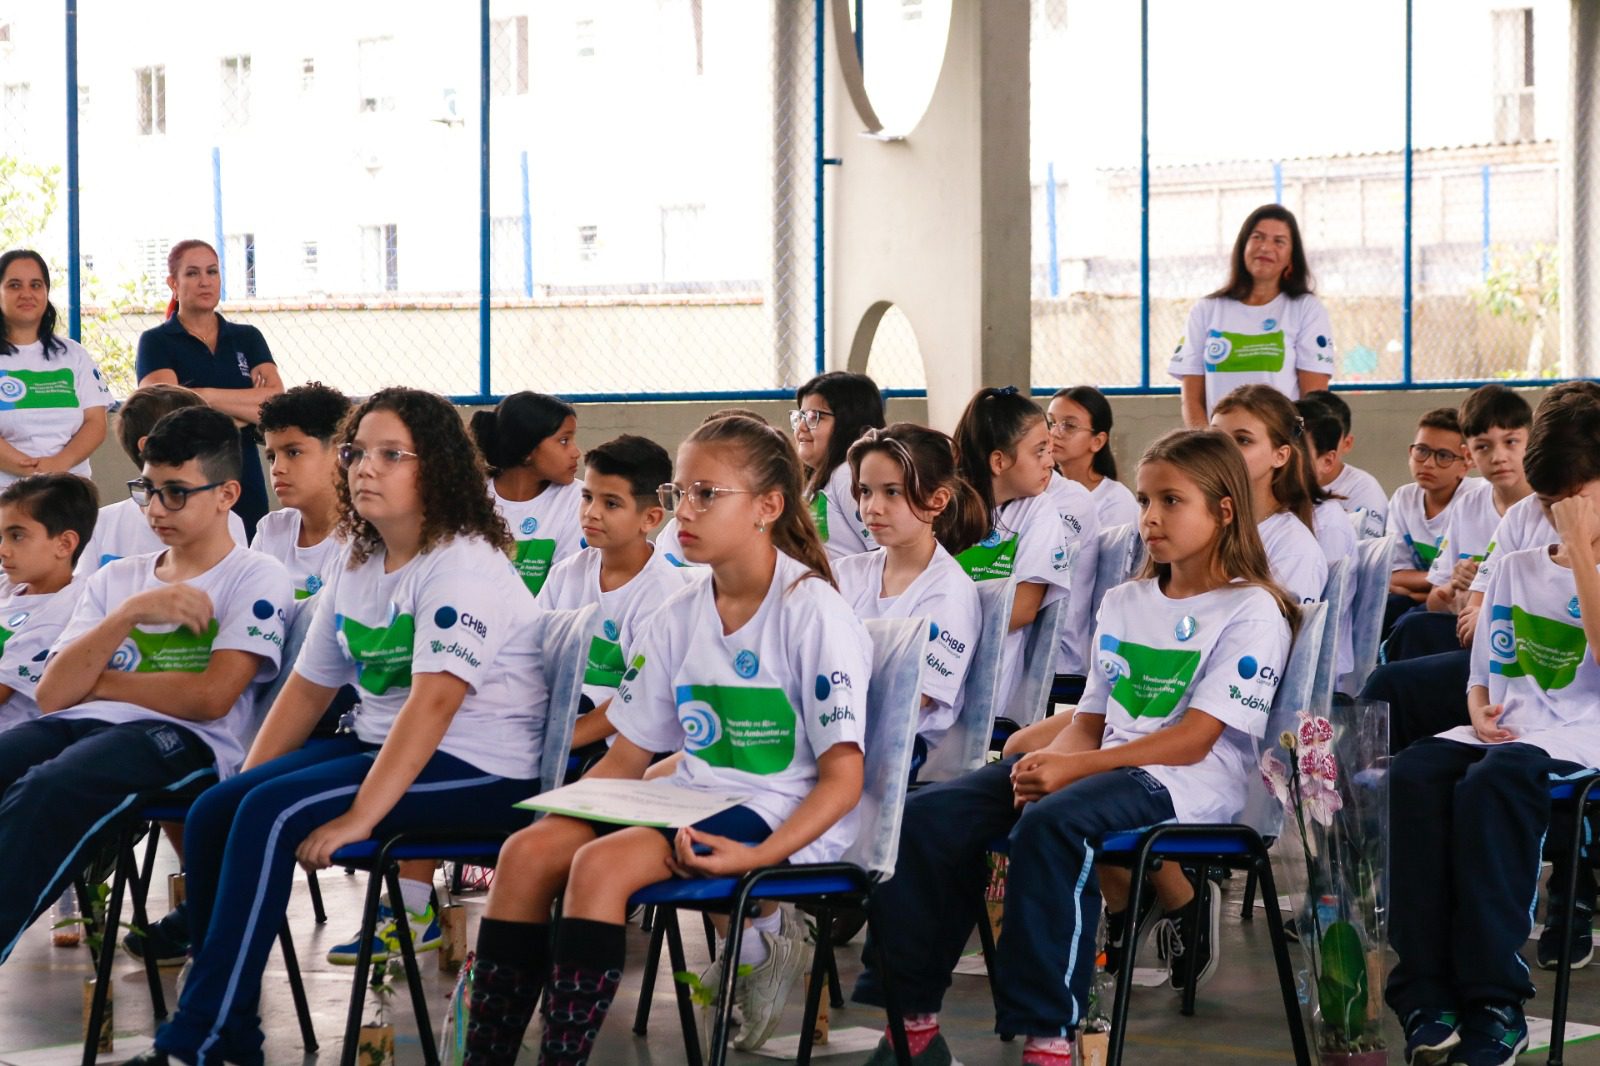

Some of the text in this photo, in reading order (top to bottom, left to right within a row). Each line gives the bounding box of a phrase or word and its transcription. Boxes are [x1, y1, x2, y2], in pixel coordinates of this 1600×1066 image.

[460, 612, 488, 639] CHBB
[446, 641, 482, 668] döhler
[940, 630, 966, 654] CHBB
